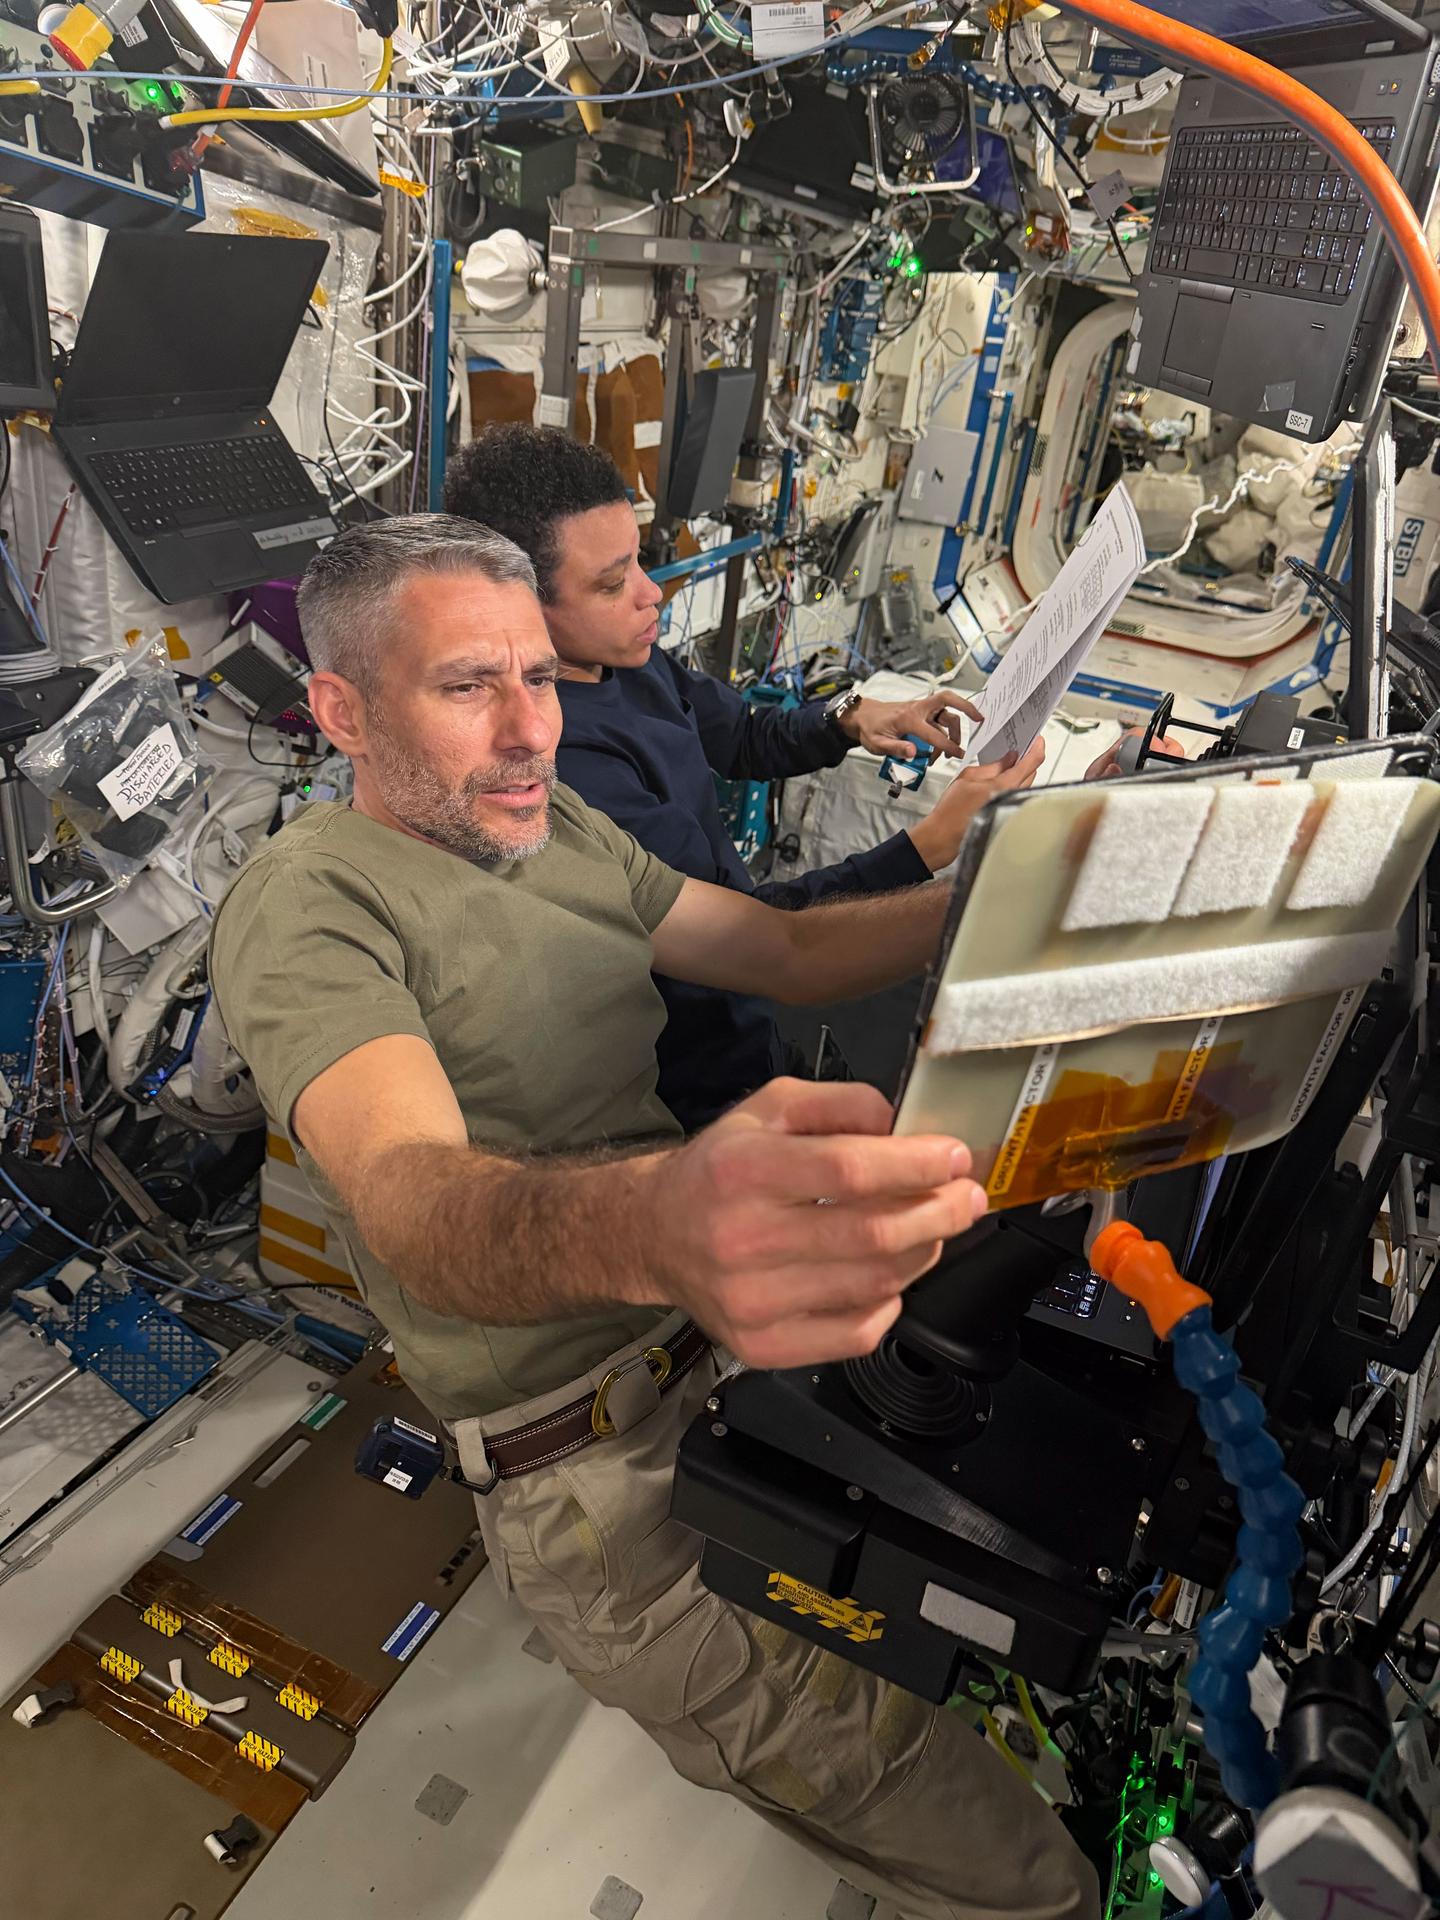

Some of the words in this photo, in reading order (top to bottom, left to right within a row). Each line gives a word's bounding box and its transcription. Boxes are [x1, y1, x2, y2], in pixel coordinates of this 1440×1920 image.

[1393, 519, 1421, 575] STBD
[117, 744, 171, 800] DISCHARGED
[128, 753, 175, 805] BATTERIES
[1181, 1035, 1210, 1091] FACTOR
[1291, 1066, 1320, 1122] GROWTH
[1316, 1012, 1344, 1063] FACTOR
[994, 1127, 1025, 1190] GROWTH
[1017, 1064, 1047, 1126] FACTOR
[797, 1583, 832, 1603] CAUTION
[797, 1590, 809, 1598] AND
[104, 1653, 118, 1665] PINCH
[118, 1663, 136, 1676] HAZARD
[171, 1696, 185, 1707] PINCH
[185, 1705, 204, 1719] HAZARD
[242, 1740, 257, 1750] PINCH
[257, 1748, 277, 1763] HAZARD
